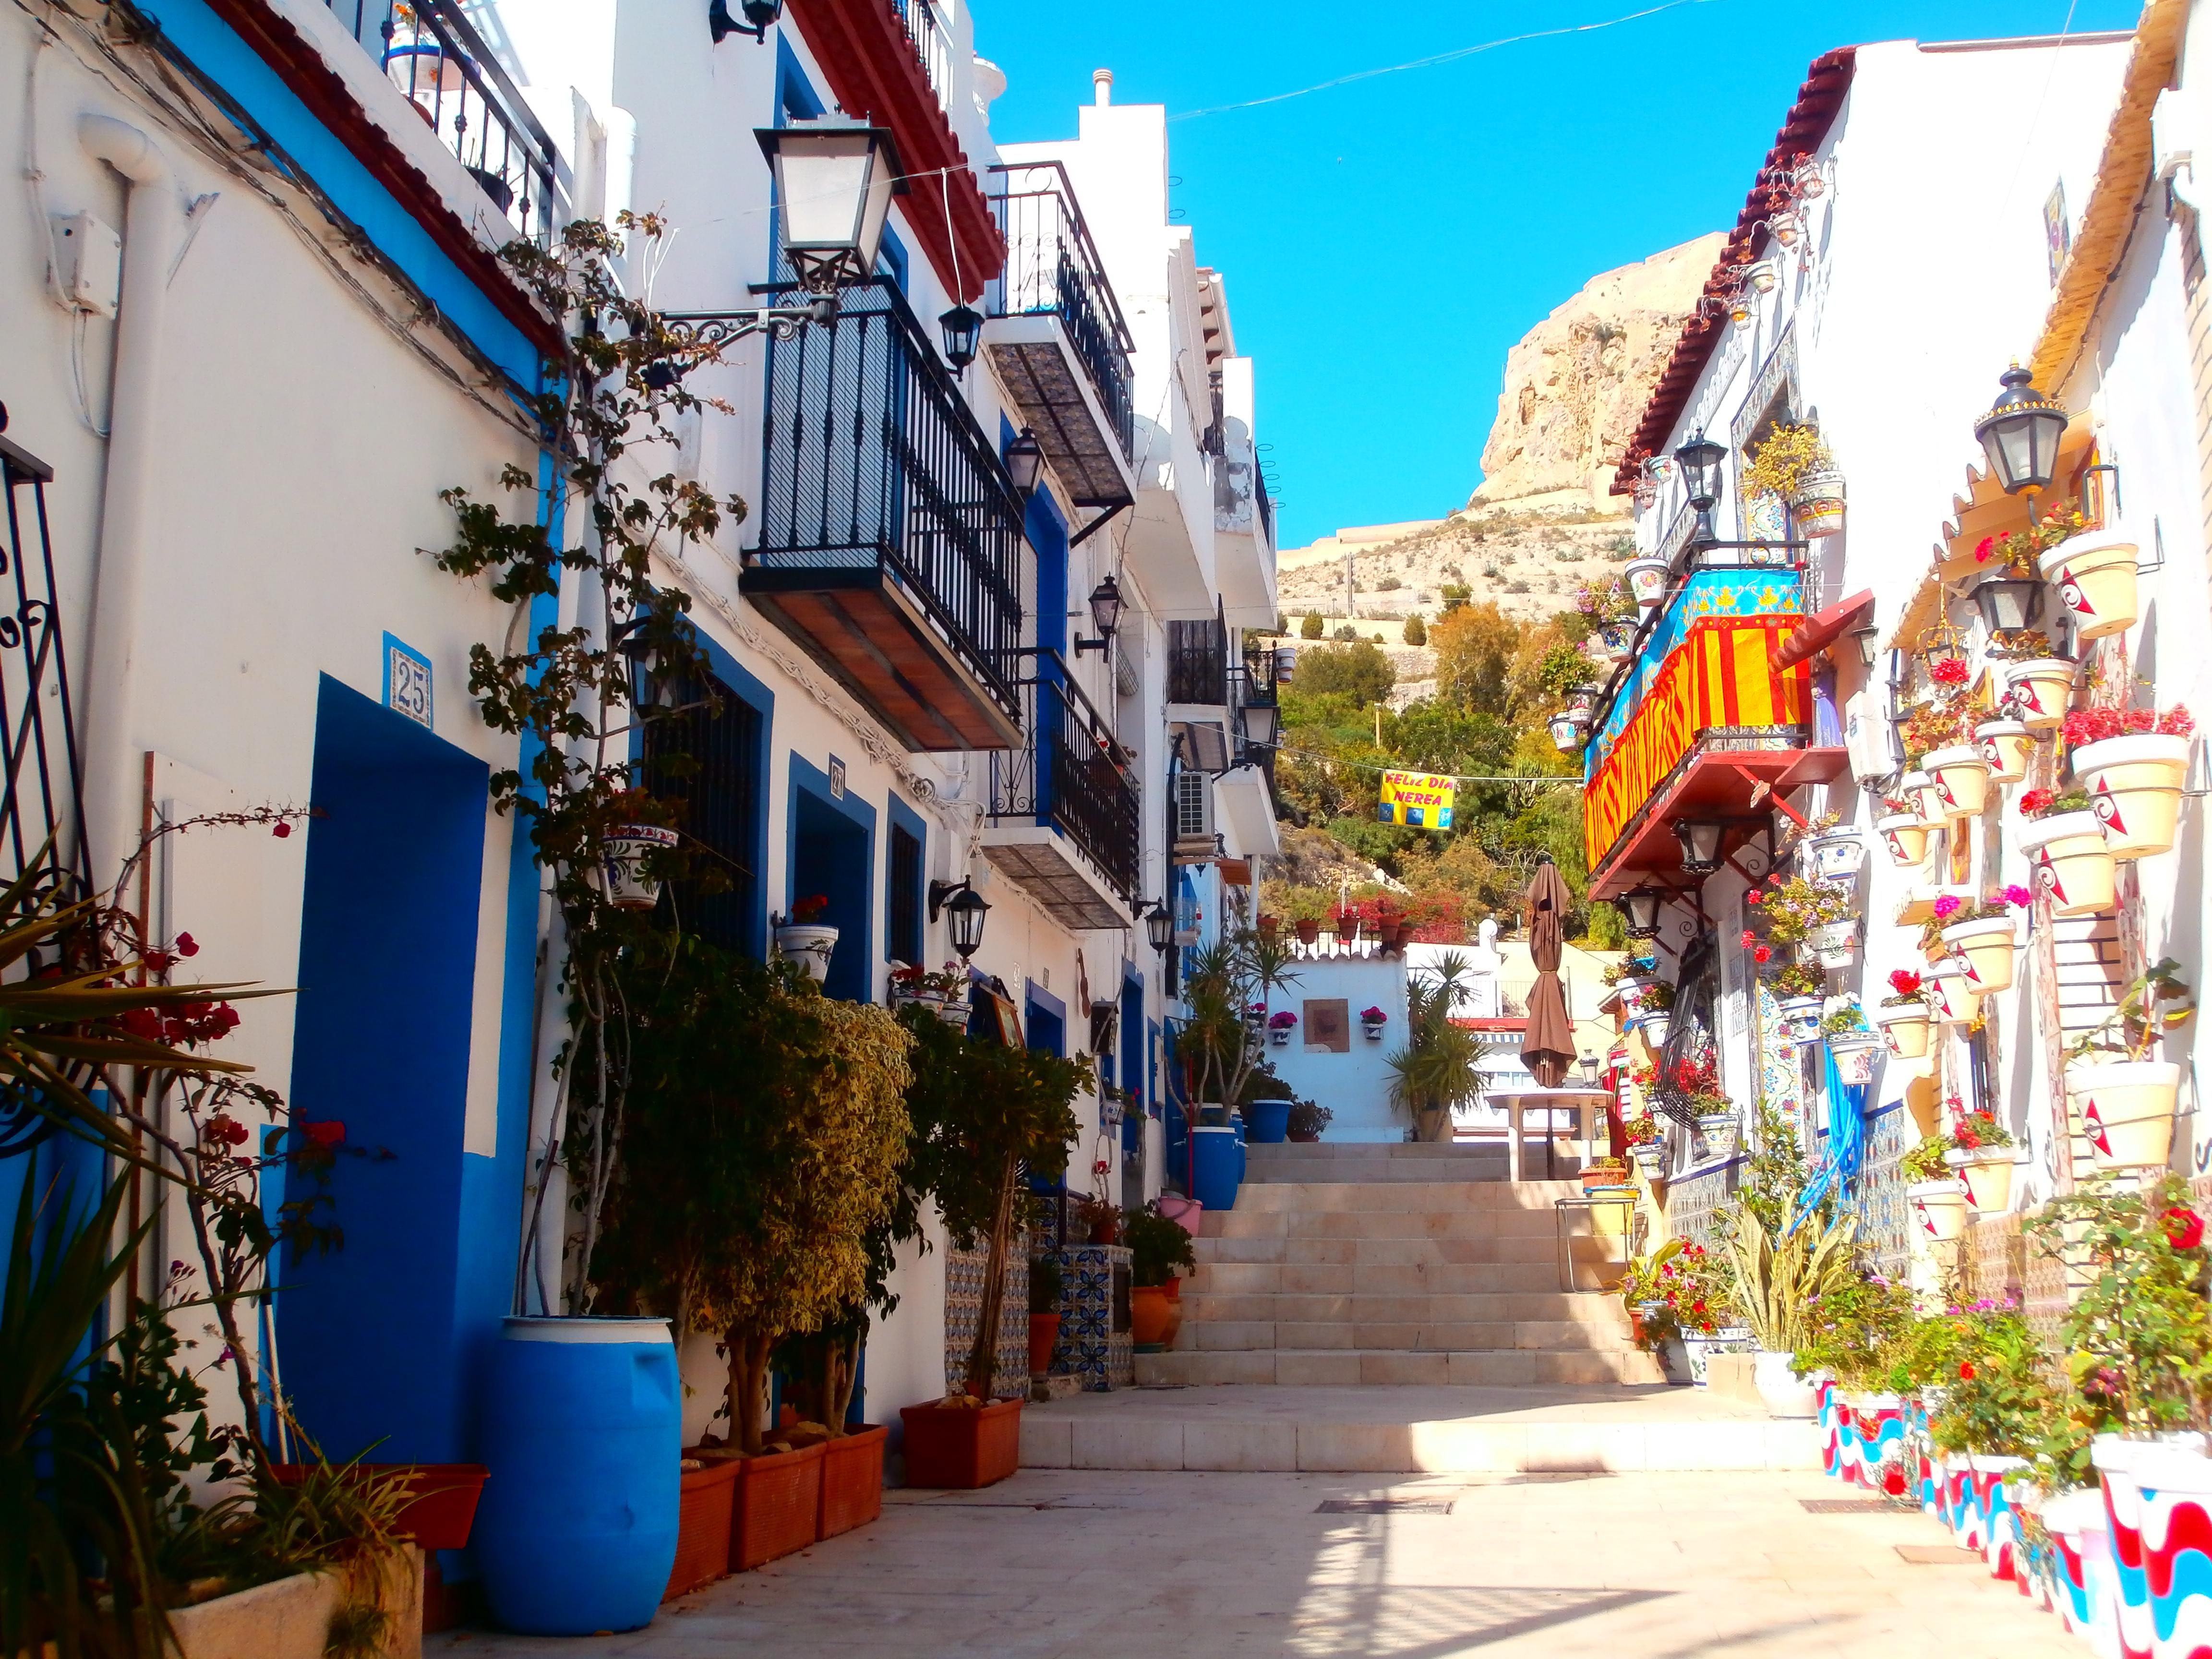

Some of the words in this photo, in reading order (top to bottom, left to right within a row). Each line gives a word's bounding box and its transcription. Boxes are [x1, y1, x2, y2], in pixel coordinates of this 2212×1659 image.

[399, 661, 424, 714] 25
[1386, 773, 1424, 786] FELIZ
[1429, 778, 1453, 790] DIA
[1394, 791, 1442, 805] NEREA
